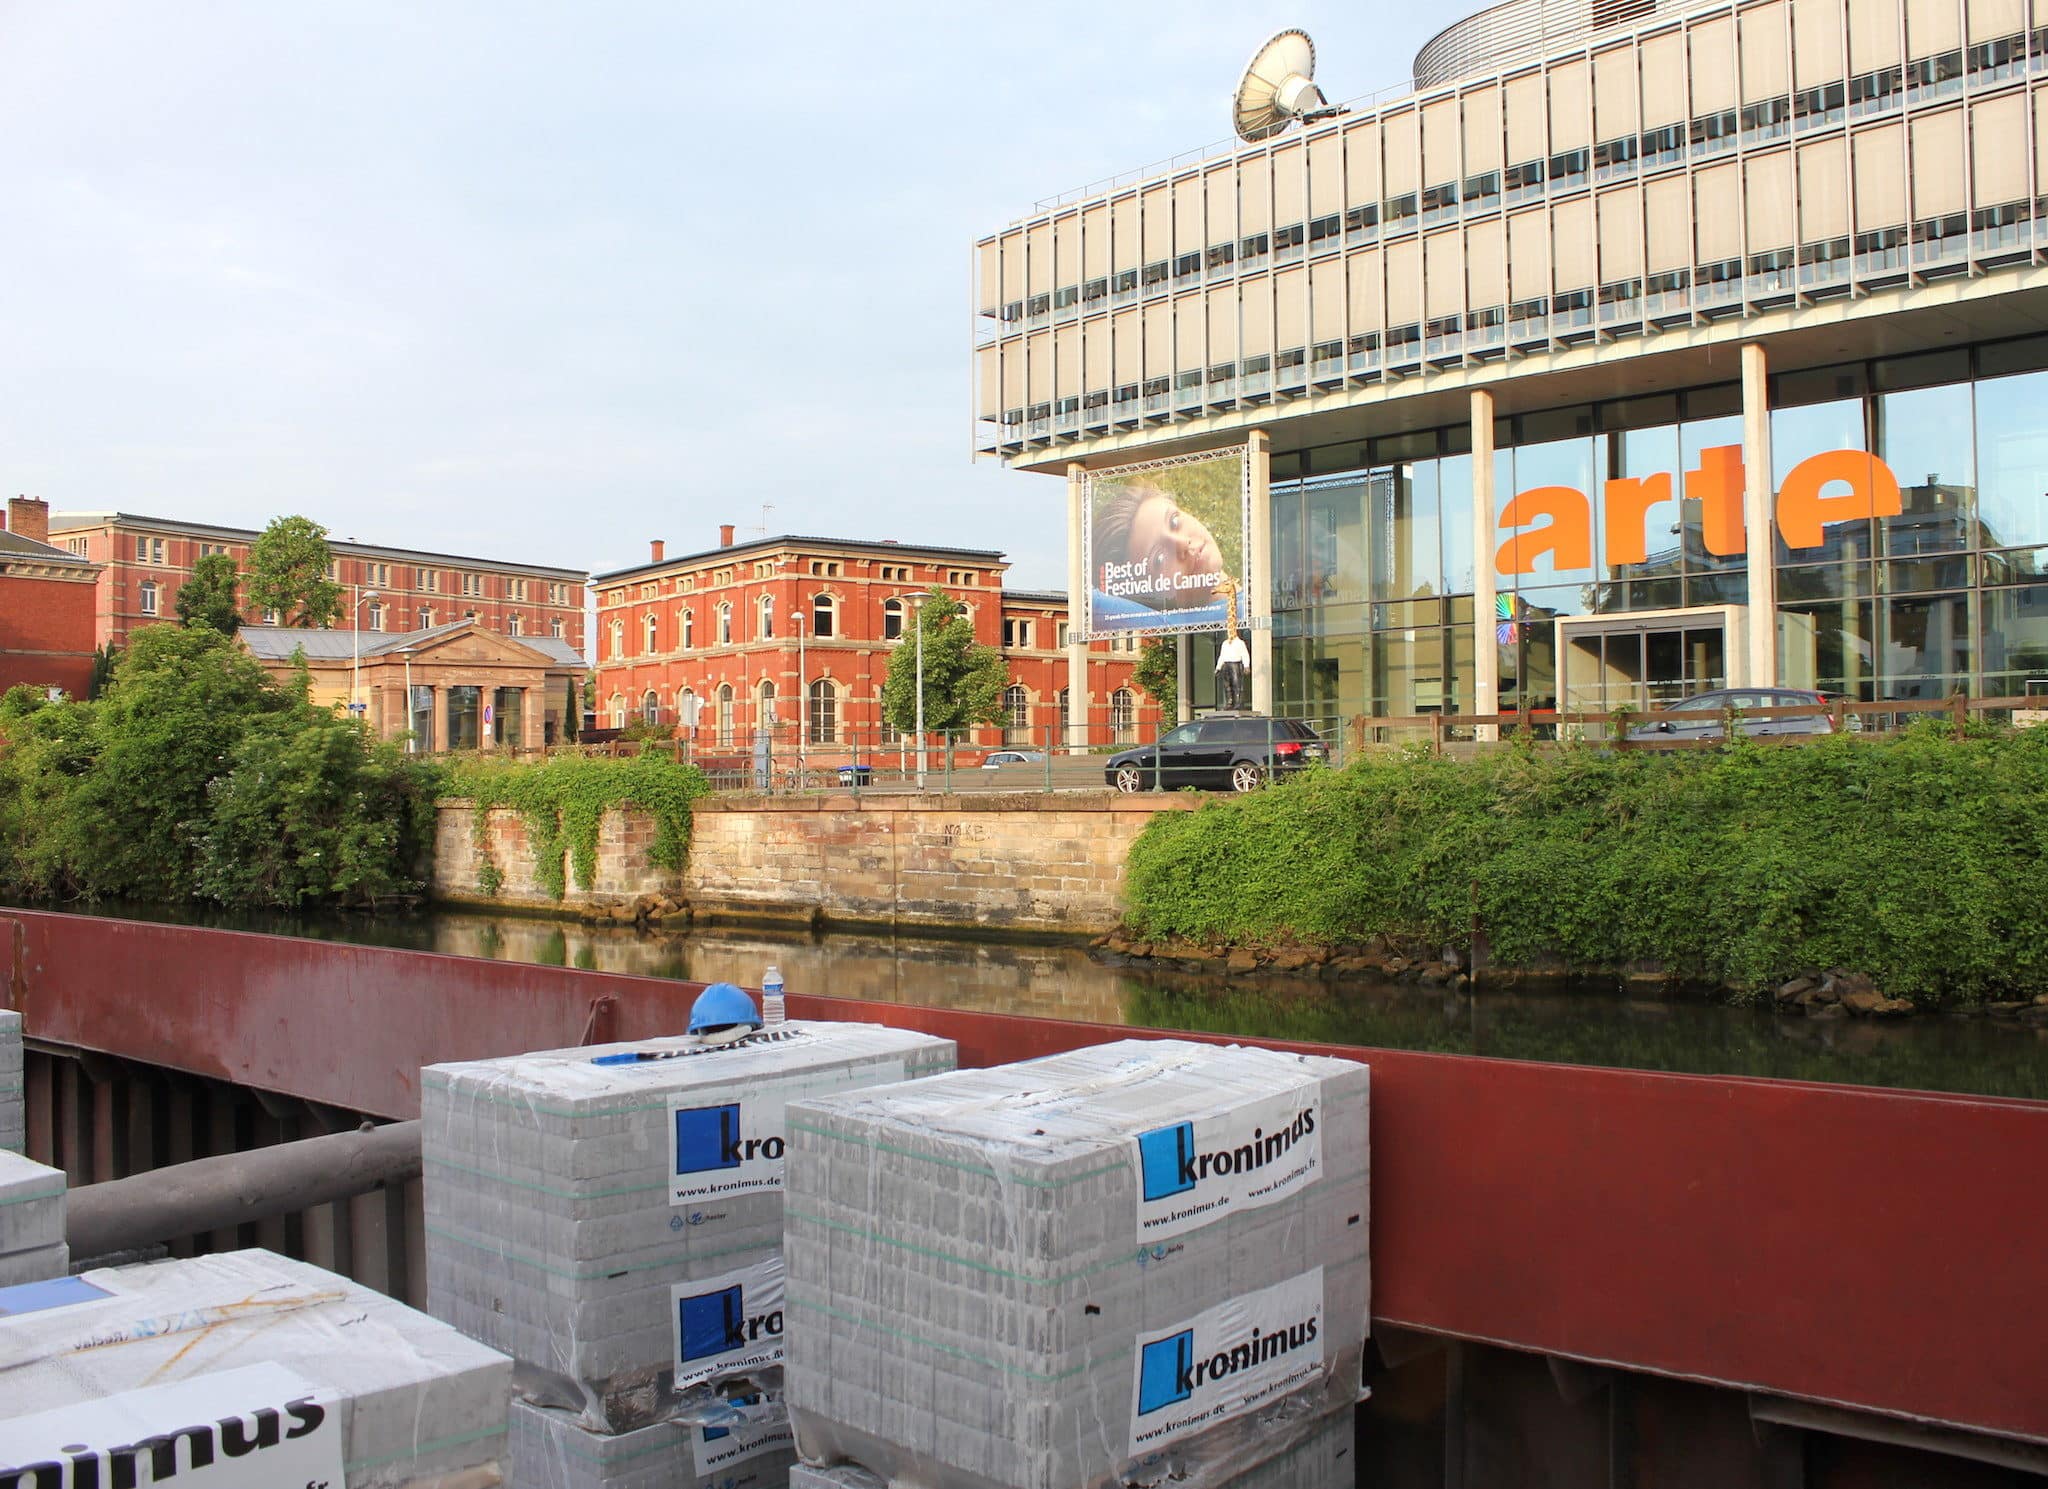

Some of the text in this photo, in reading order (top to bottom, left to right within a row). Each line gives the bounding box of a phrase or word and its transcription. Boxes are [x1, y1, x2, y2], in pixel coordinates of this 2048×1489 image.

[1495, 444, 1902, 575] arte
[1105, 561, 1132, 579] Best
[1134, 557, 1148, 577] of
[1105, 574, 1152, 596] Festival
[1155, 574, 1171, 592] de
[1173, 571, 1221, 590] Cannes
[1176, 1108, 1315, 1185] kronimus
[676, 1177, 781, 1198] www.kronimus.de
[1143, 1158, 1316, 1229] www.kronimus.de www.kronimus.fr
[1176, 1316, 1317, 1395] kronimus
[1135, 1404, 1226, 1443] www.kronimus.de
